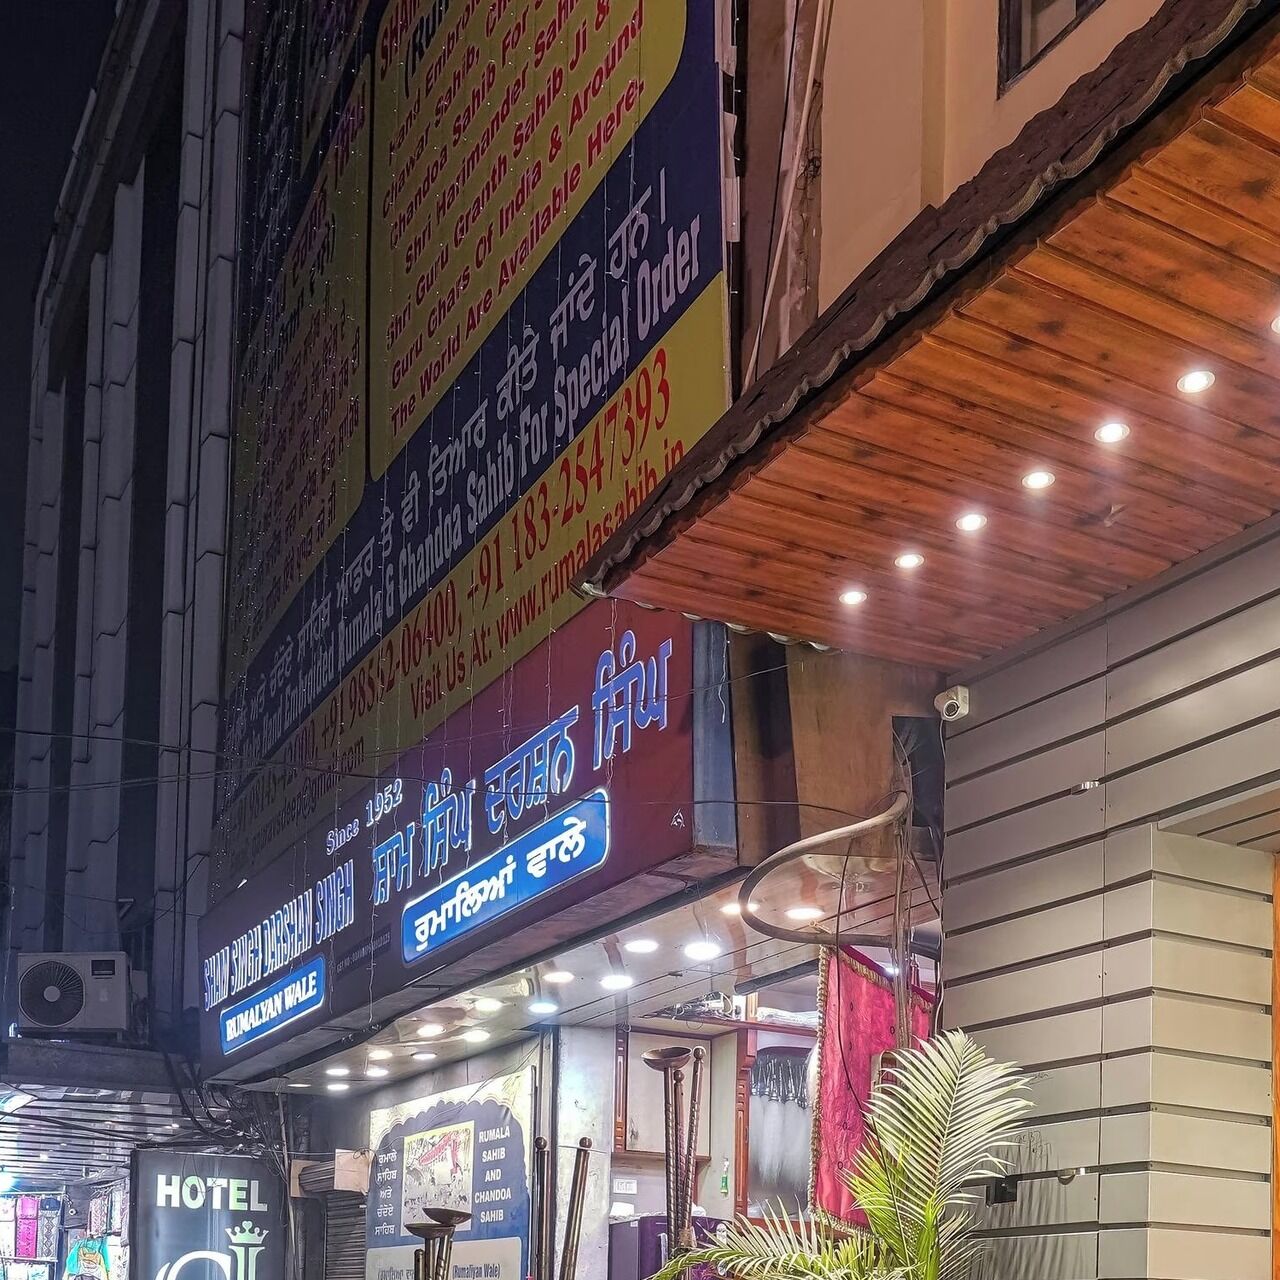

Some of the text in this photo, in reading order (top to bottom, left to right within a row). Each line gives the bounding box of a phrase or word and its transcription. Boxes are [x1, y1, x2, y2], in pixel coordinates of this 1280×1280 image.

[453, 61, 495, 148] Sahib
[502, 6, 528, 67] For
[392, 0, 643, 390] Guru Ghars Of India & Around
[405, 219, 430, 275] Shri
[437, 64, 528, 223] Harimander
[416, 244, 448, 308] Guru
[454, 152, 507, 249] Granth
[513, 64, 563, 159] Sahib
[569, 20, 586, 74] Ji
[392, 393, 415, 436] The
[420, 325, 459, 400] World
[466, 286, 492, 339] Are
[499, 161, 580, 293] Available
[496, 325, 539, 423] ਕੀਤੇ
[549, 255, 597, 361] ਜਾਂਦੇ
[338, 583, 382, 673] Rumala
[386, 560, 393, 618] &
[399, 497, 461, 608] Chandoa
[467, 430, 514, 535] Sahib
[520, 398, 547, 480] For
[554, 281, 629, 443] Special
[637, 211, 699, 346] Order
[467, 529, 503, 609] +91
[512, 342, 669, 576] 183-2547393
[411, 662, 441, 719] Visit
[446, 645, 464, 686] Us
[472, 619, 490, 675] At:
[423, 767, 476, 877] ਸਿੰਘ
[592, 630, 672, 771] ਸਿੰਘ
[326, 778, 403, 856] Since 1952
[204, 947, 230, 1012] SHAM
[231, 925, 262, 996] SINGH
[263, 888, 313, 978] DARSHAN
[315, 858, 354, 945] SINGH
[414, 855, 517, 951] ਰੁਮਾਲਿਆਂ
[526, 816, 588, 879] ਵਾਲੇ
[225, 970, 317, 1042] RUMALYAN WALE
[377, 1168, 397, 1182] ਸਾਹਿਬ
[478, 1125, 511, 1143] RUMALA
[481, 1147, 506, 1163] SAHIB
[484, 1168, 502, 1182] AND
[156, 1174, 268, 1212] HOTEL
[374, 1224, 396, 1236] ਸਾਹਿਬ
[474, 1187, 512, 1204] CHANDOA
[480, 1209, 504, 1223] SAHIB
